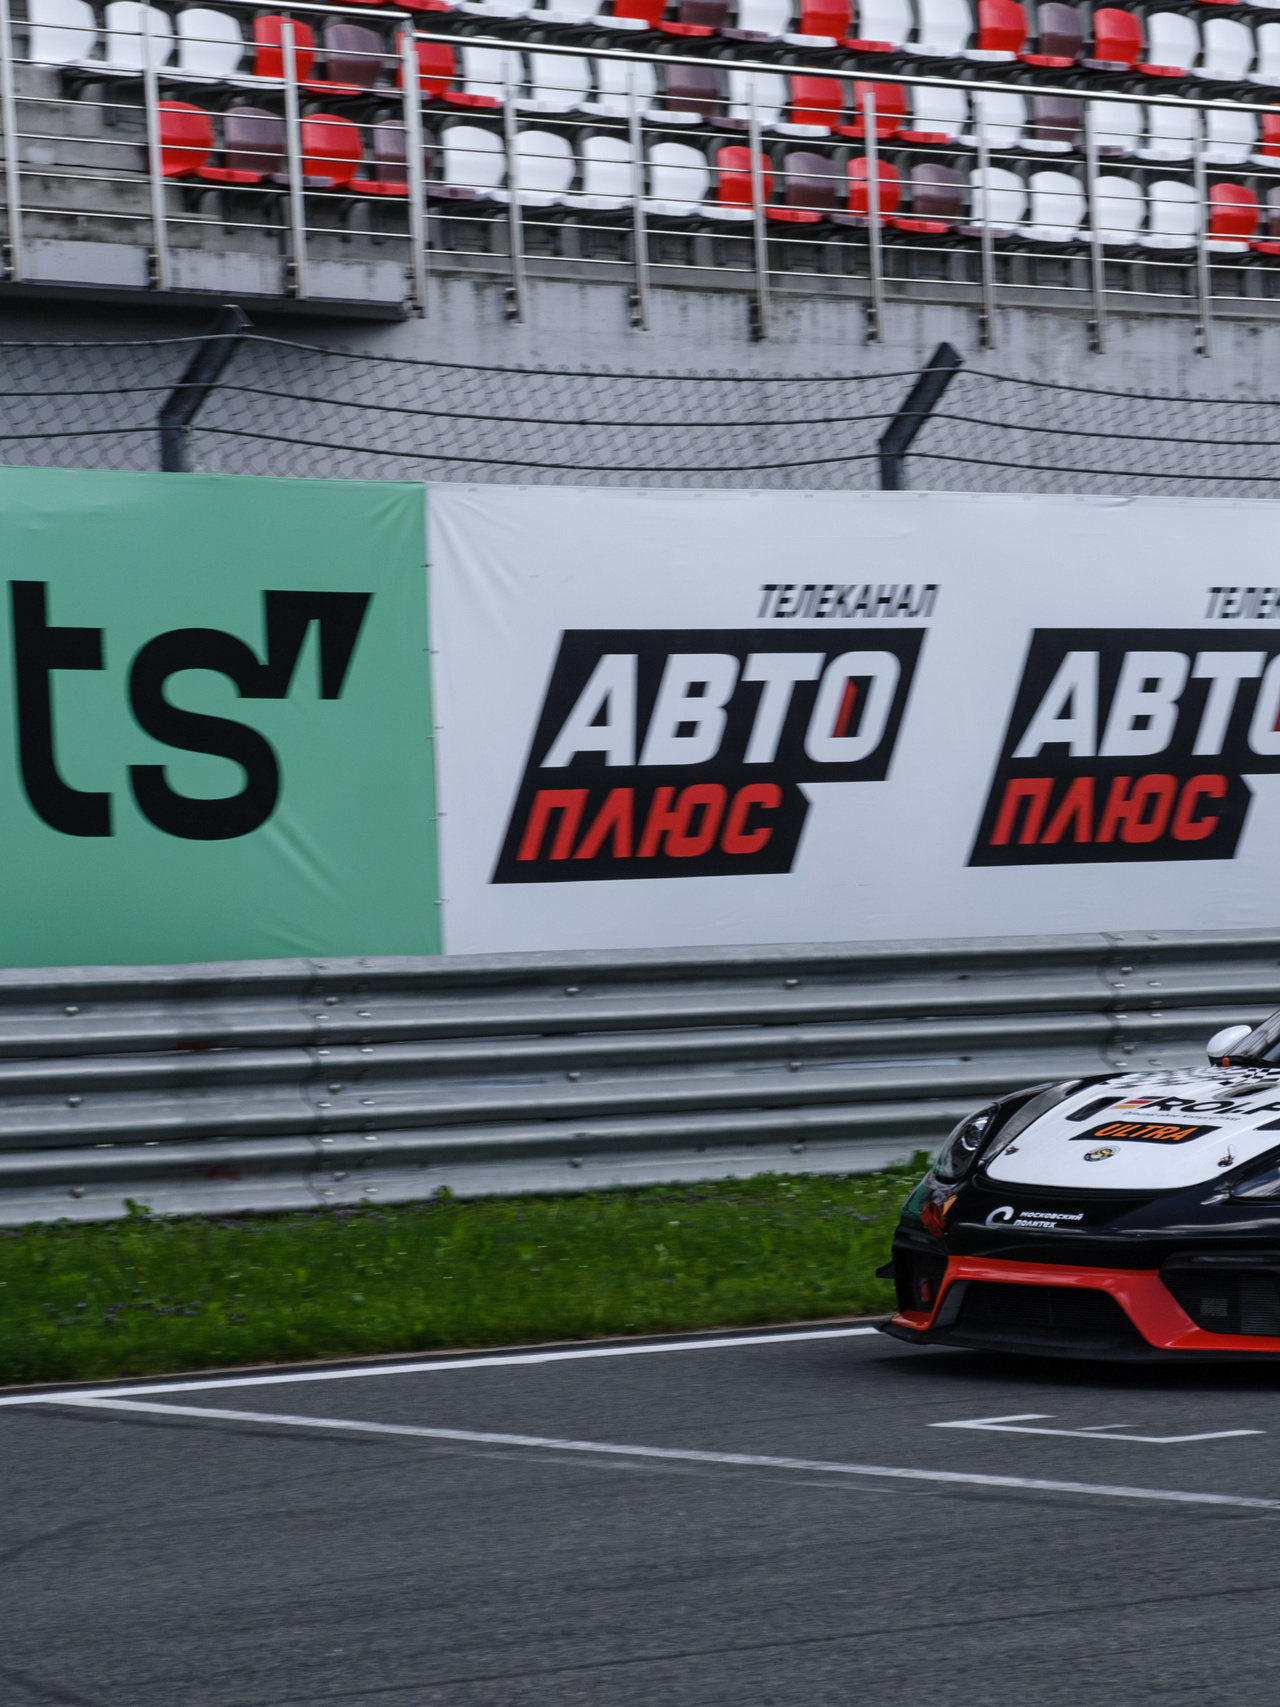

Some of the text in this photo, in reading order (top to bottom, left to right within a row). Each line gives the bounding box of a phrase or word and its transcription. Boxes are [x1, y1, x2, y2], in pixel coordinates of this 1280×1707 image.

[757, 583, 940, 619] ТЕЛЕКАНАЛ
[540, 650, 902, 768] АВТО
[516, 782, 783, 862] ПЛЮС
[989, 773, 1228, 846] ПЛЮС
[1094, 1123, 1198, 1141] ULTRA
